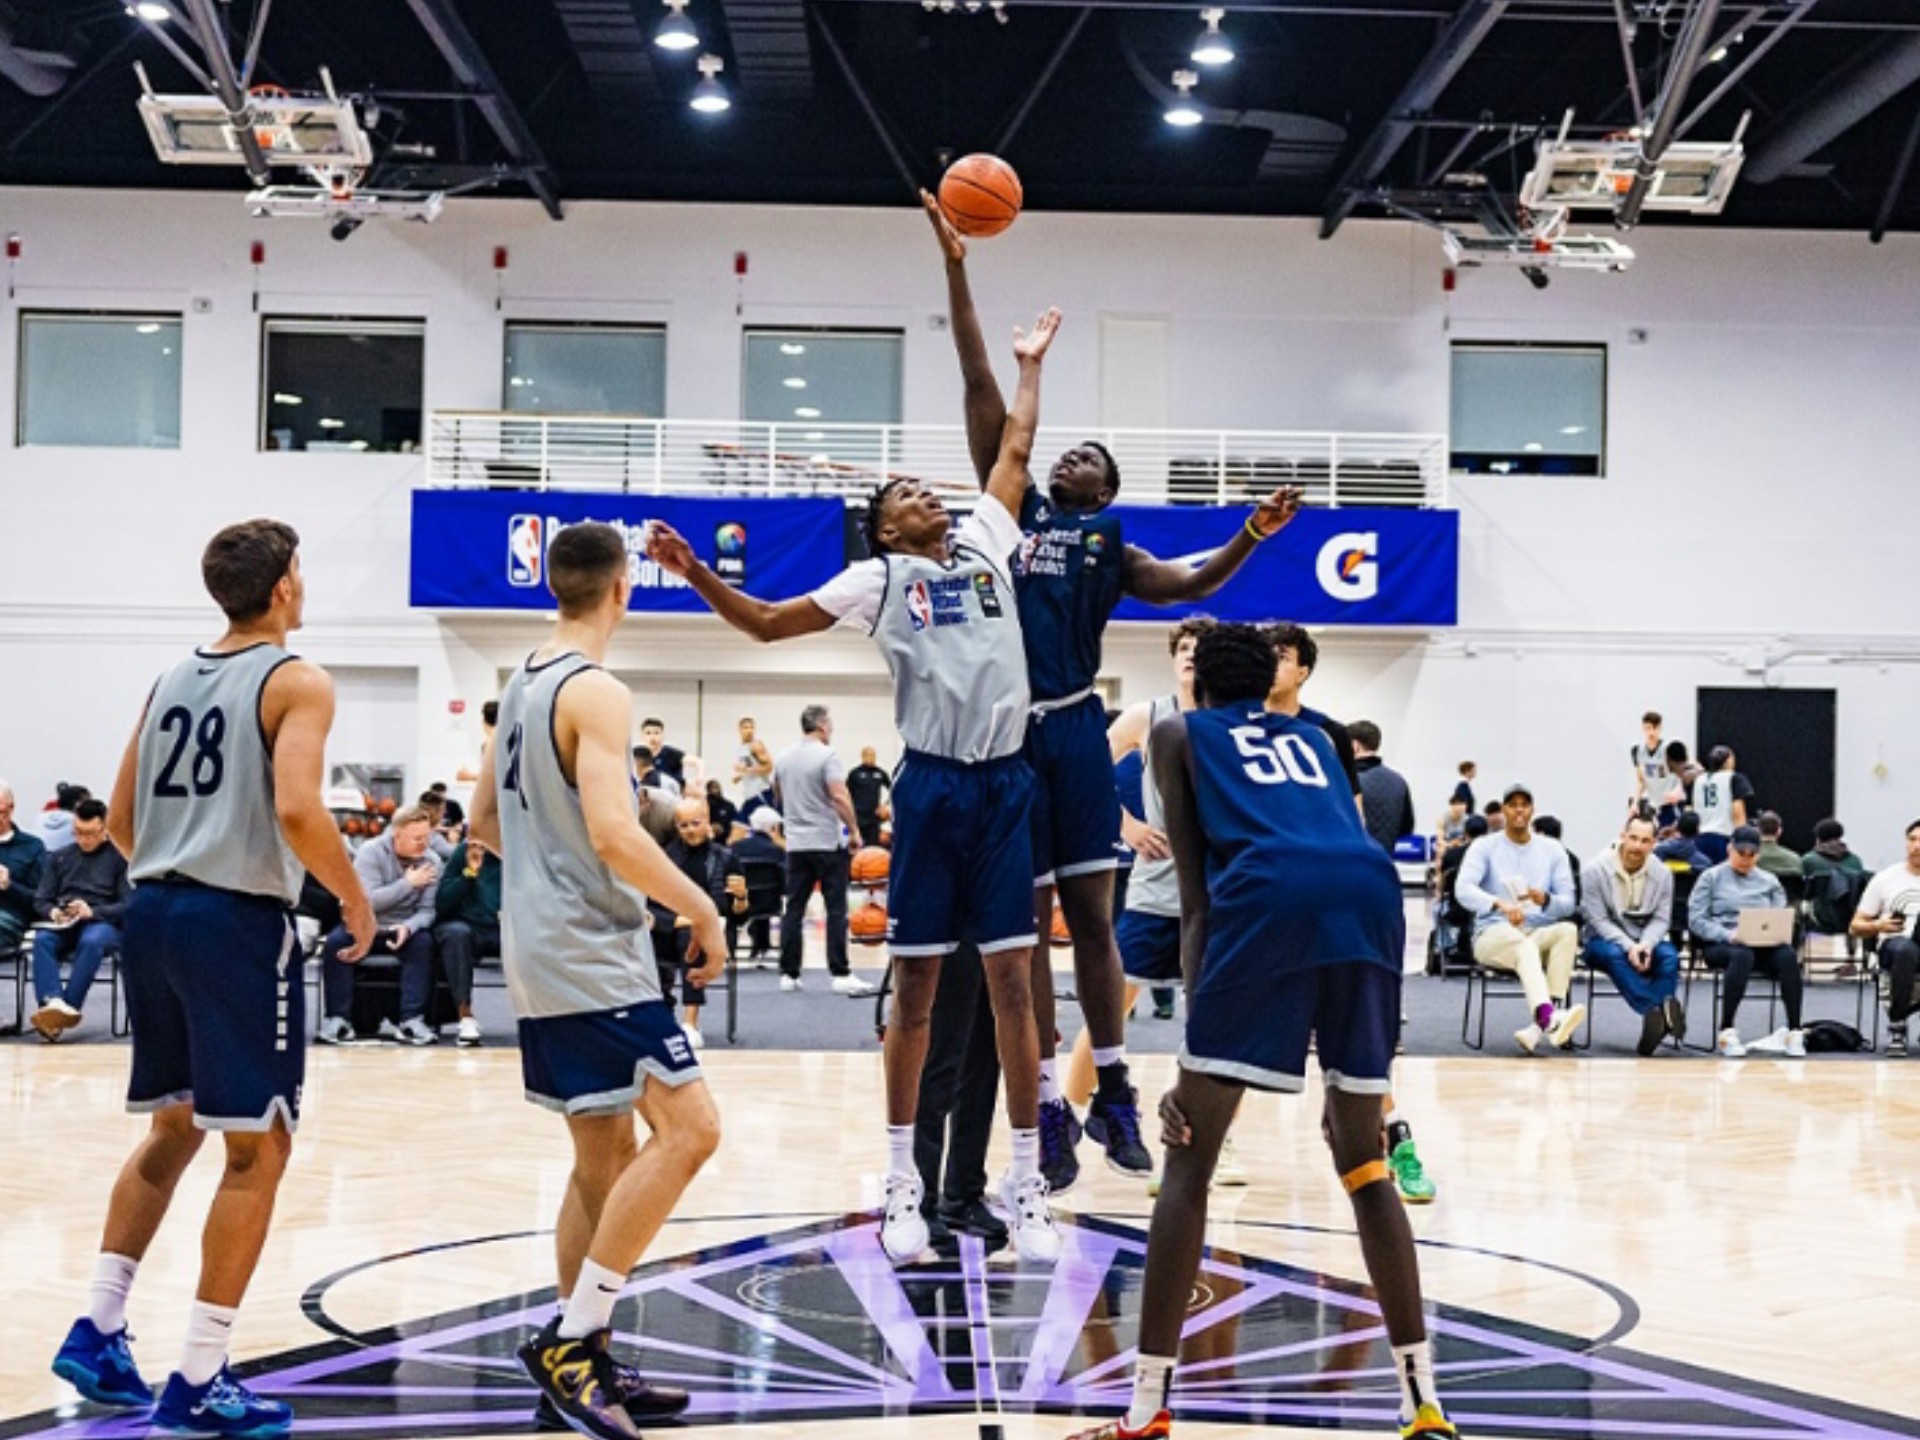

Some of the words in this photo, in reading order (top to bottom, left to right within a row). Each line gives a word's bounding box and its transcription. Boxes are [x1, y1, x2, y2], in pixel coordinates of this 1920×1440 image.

[1316, 532, 1378, 601] G
[153, 704, 226, 798] 28
[1228, 725, 1329, 788] 50
